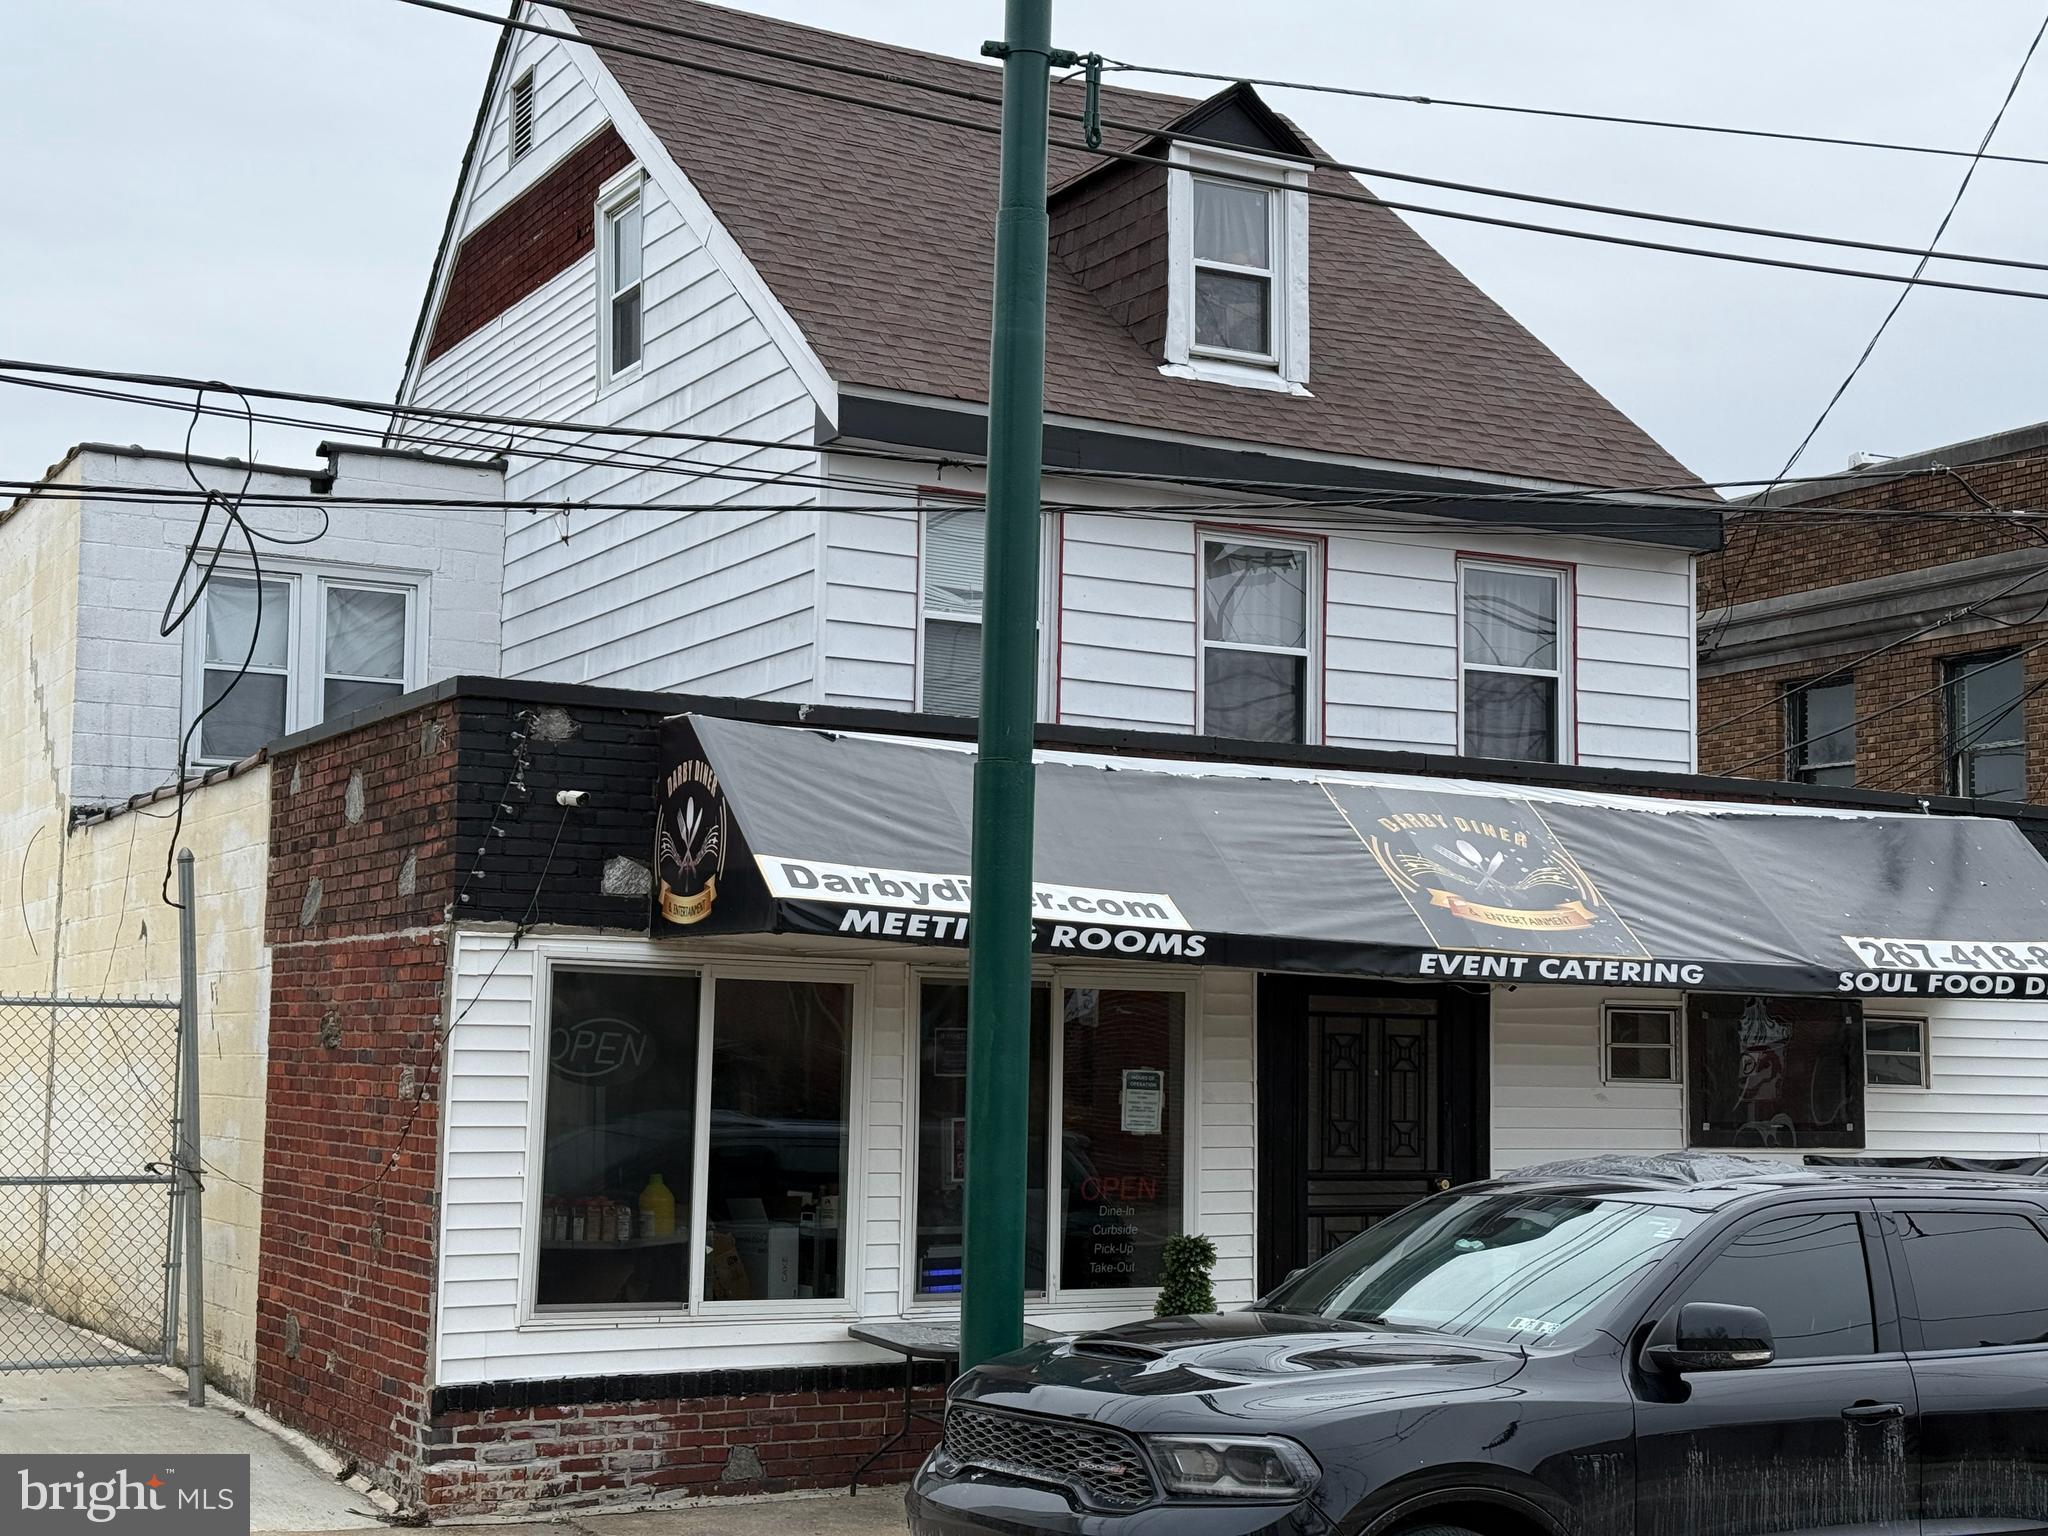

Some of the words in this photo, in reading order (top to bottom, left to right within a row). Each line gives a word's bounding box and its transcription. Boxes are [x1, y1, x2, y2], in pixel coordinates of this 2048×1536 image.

[667, 760, 693, 798] DARBY
[694, 760, 718, 798] DINER
[1377, 813, 1448, 833] DARBY
[1454, 816, 1528, 848] DINER
[781, 863, 1169, 919] Darbydir.com
[1485, 911, 1573, 926] ENTERTAINMENT
[839, 909, 1037, 943] MEETI
[1050, 925, 1207, 957] ROOMS
[1419, 954, 1529, 978] EVENT
[1538, 959, 1705, 984] CATERING
[1838, 971, 1918, 993] SOUL
[1928, 974, 2015, 995] FOOD
[551, 1027, 647, 1066] OPEN
[1081, 1176, 1157, 1200] OPEN
[1099, 1205, 1135, 1217] Dine-In
[1092, 1224, 1138, 1236] Curbside
[1094, 1243, 1134, 1256] Pick-Up
[1090, 1262, 1136, 1273] Take-Out
